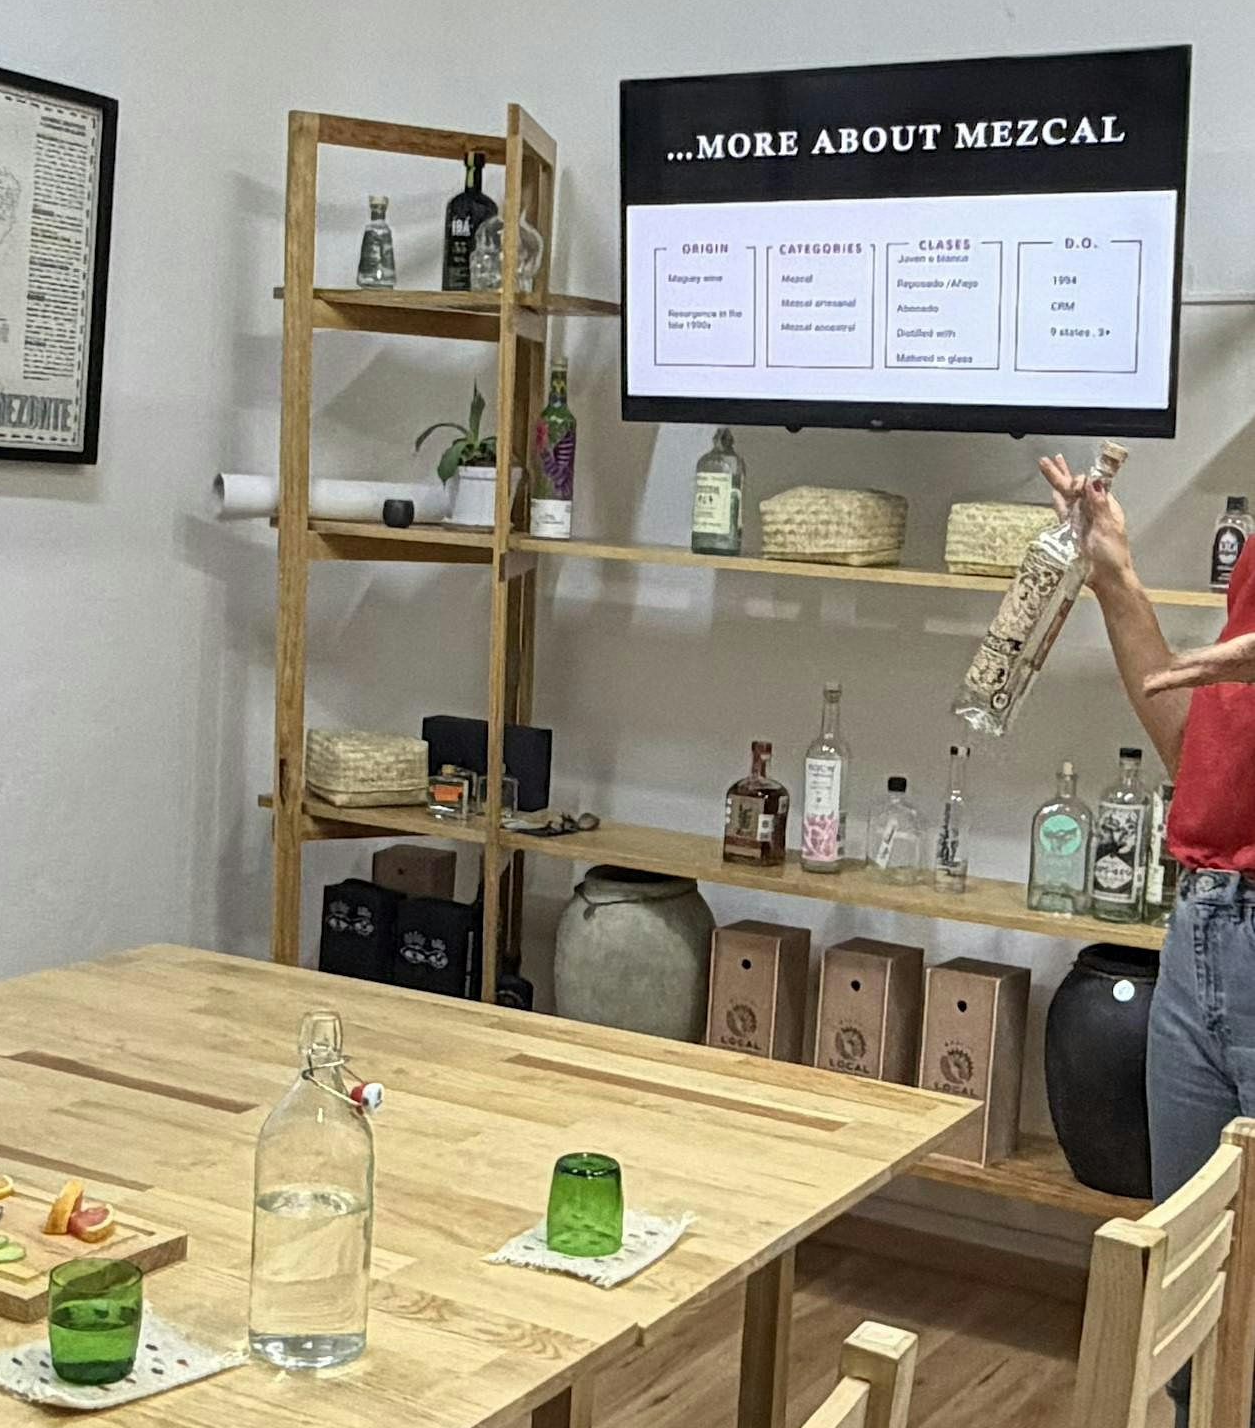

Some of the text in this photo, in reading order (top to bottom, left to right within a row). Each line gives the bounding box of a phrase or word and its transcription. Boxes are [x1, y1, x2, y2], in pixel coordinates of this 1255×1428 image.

[810, 123, 942, 155] ABOUT
[954, 115, 1126, 150] MEZCAL
[682, 243, 728, 254] ORIGIN
[779, 243, 862, 255] CATEGORIES
[919, 239, 970, 251] CLASES
[1065, 237, 1098, 249] D.O.
[720, 1035, 761, 1050] LOCAL
[829, 1058, 870, 1074] LOCAL
